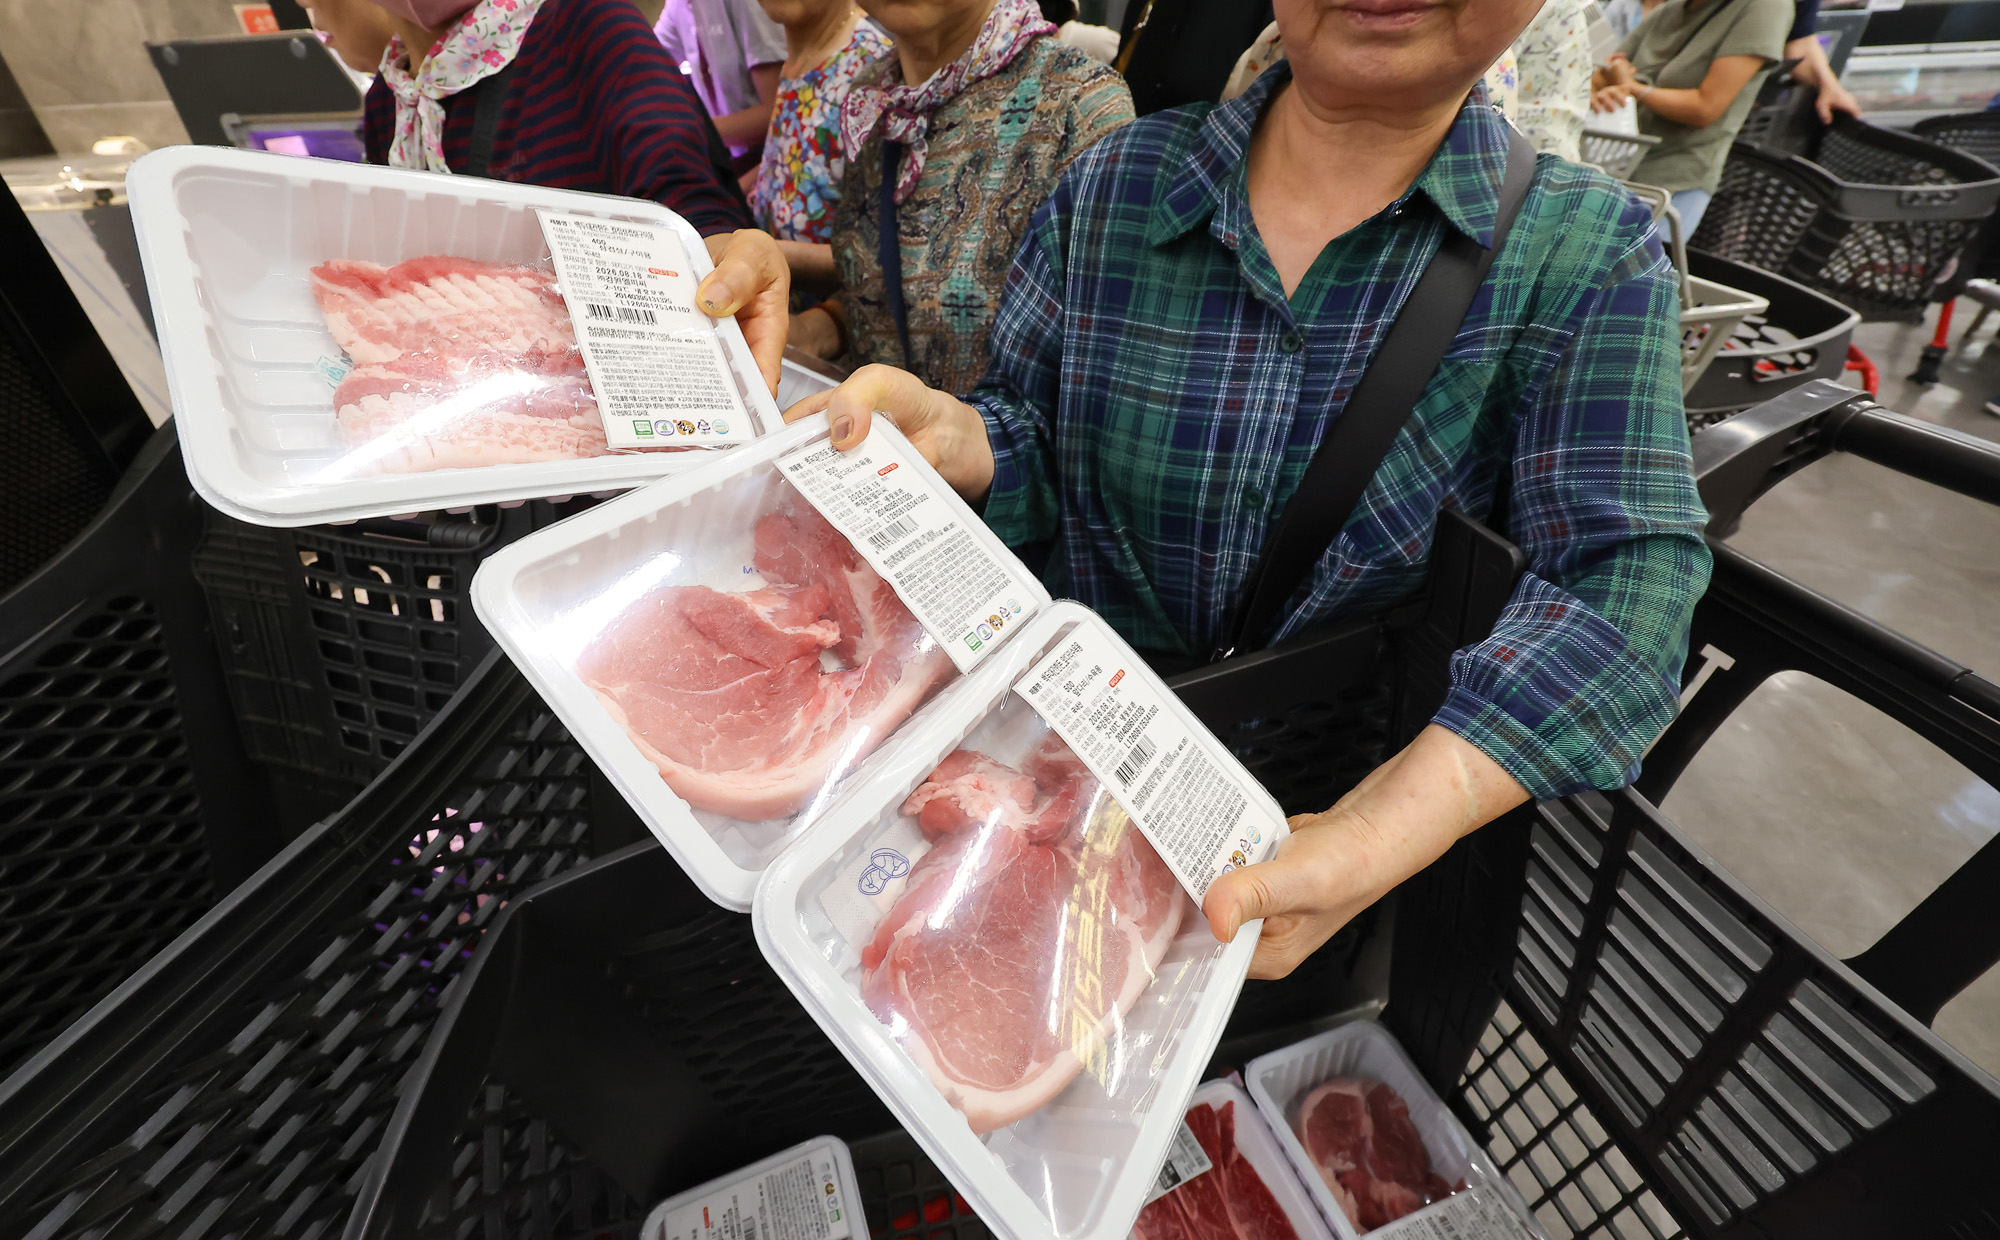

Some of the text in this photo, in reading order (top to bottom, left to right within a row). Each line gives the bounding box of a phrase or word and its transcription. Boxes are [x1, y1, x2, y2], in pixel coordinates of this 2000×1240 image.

[596, 267, 642, 279] 2026.08.18
[825, 467, 838, 475] 500
[1063, 681, 1075, 693] 500
[1072, 665, 1102, 697] 앞다리/수육용
[1029, 682, 1042, 695] 제품명
